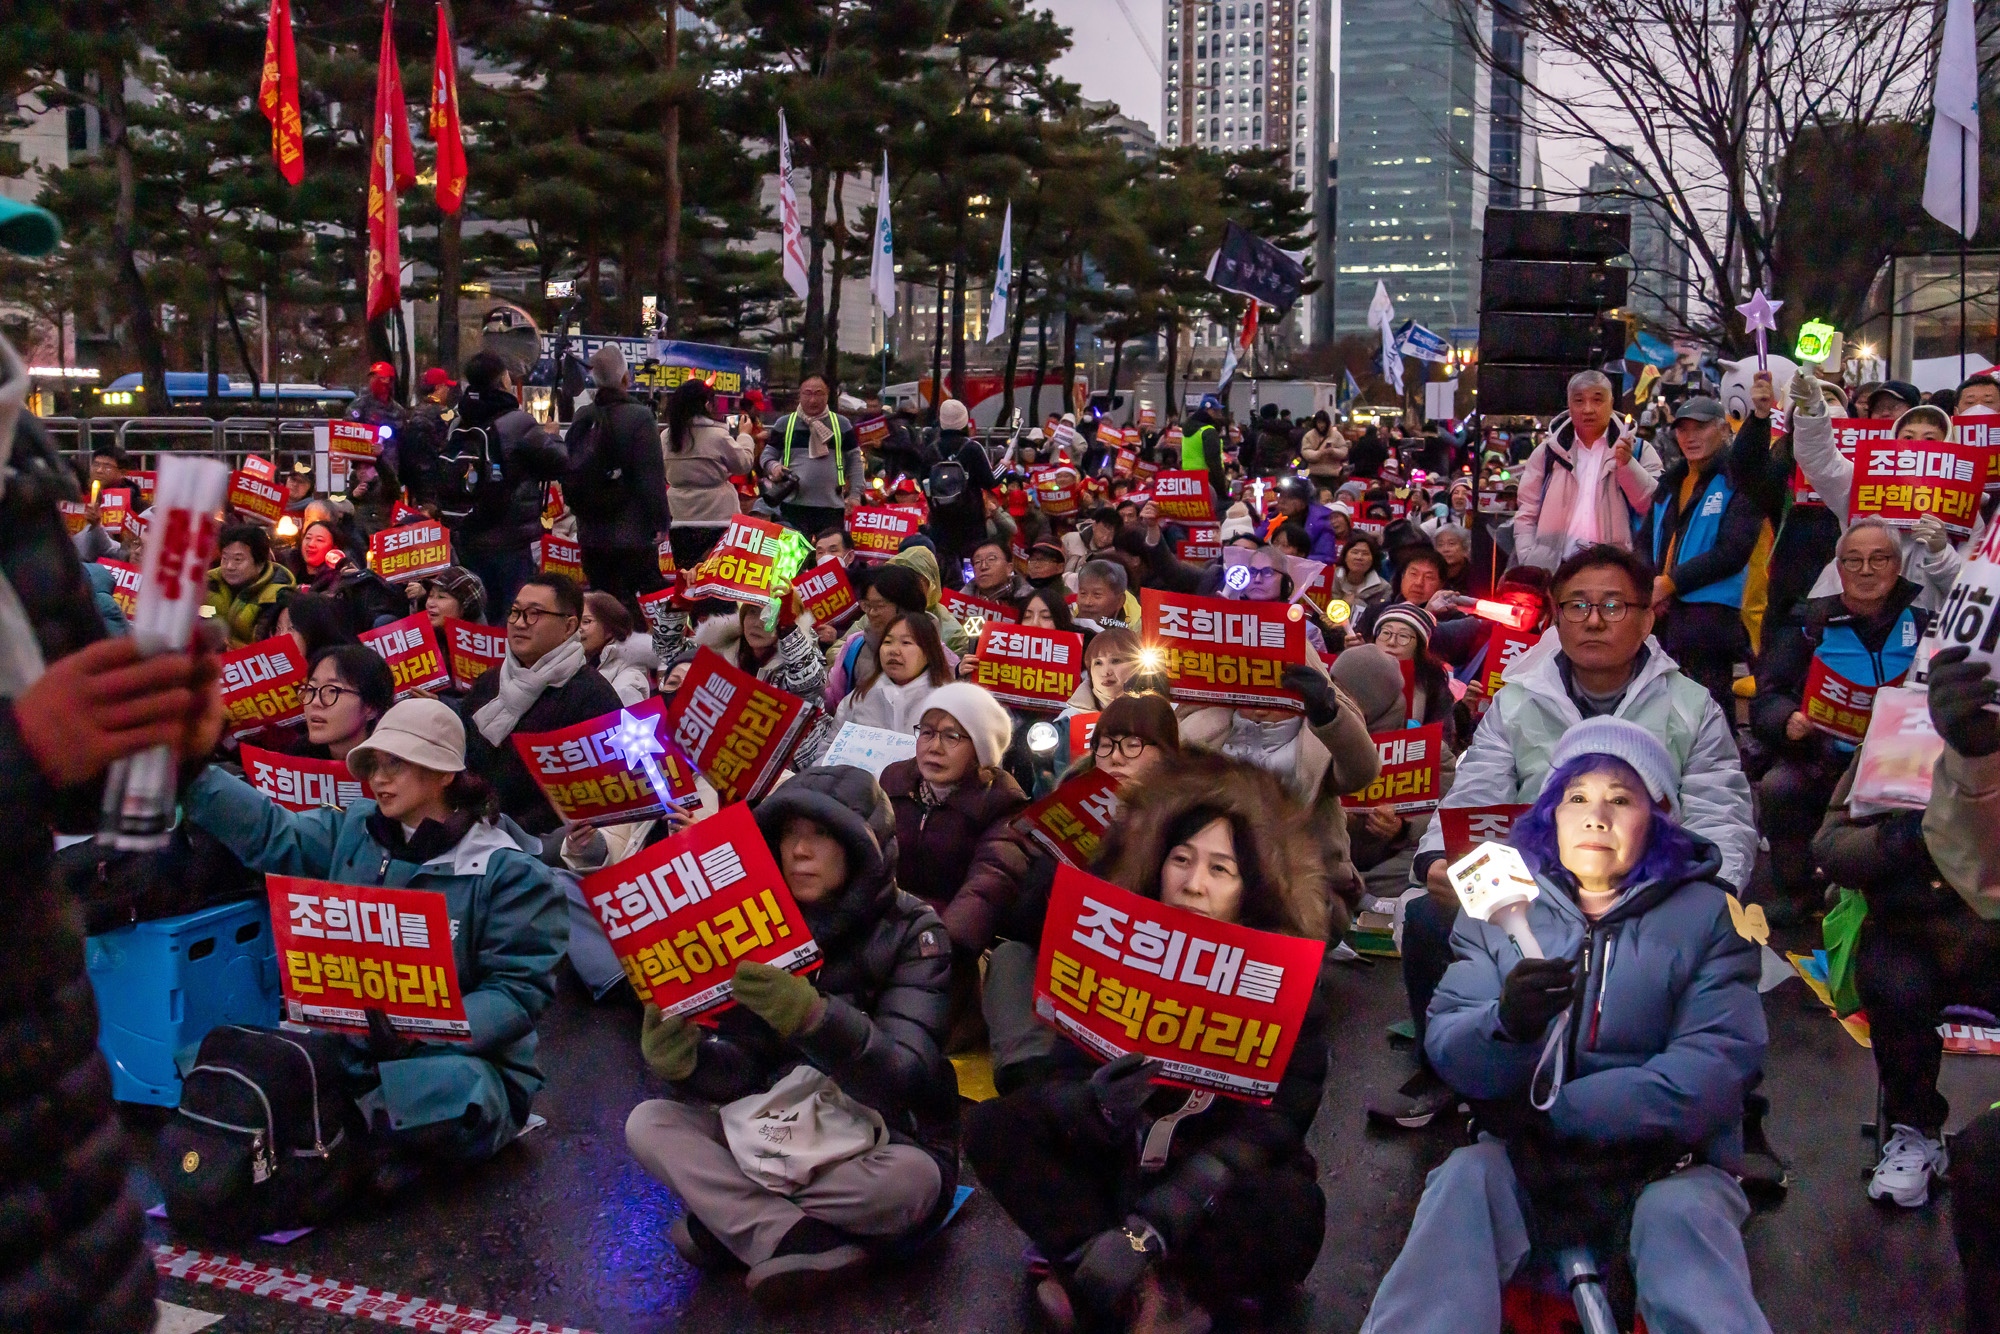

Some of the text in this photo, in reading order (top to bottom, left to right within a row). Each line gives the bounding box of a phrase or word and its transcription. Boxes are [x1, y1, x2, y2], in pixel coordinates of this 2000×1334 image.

[334, 424, 374, 441] 조희대를
[1831, 427, 1891, 452] 희대
[1955, 424, 2000, 448] 대를
[244, 456, 270, 474] 대를
[1868, 450, 1974, 482] 조희대를
[237, 476, 283, 502] 조희대를
[1156, 477, 1202, 496] 조희대를
[1858, 485, 1975, 520] 탄핵하라!
[231, 491, 281, 518] 탄핵하라!
[855, 511, 908, 533] 조희대를
[384, 526, 442, 553] 조희대를
[1185, 546, 1222, 559] 조희대
[381, 545, 447, 574] 탄핵하라!
[797, 571, 837, 602] 희대를
[813, 586, 852, 620] 하라!
[456, 627, 507, 657] 조희
[1158, 604, 1286, 649] 조희대를
[985, 630, 1070, 665] 조희대를
[391, 650, 438, 687] 하라!
[978, 660, 1074, 697] 탄핵하라!
[1163, 648, 1286, 690] 탄핵하라
[674, 672, 737, 764] 조희대를
[531, 723, 626, 774] 조희대
[708, 690, 789, 801] 탄핵하라!
[1378, 739, 1427, 766] 대를
[253, 760, 364, 809] 조희대를
[544, 755, 685, 813] 탄핵하라!
[1350, 767, 1432, 802] 하라!
[592, 841, 748, 941] 조희대를
[288, 893, 430, 949] 조희대를
[621, 888, 792, 1001] 탄핵하라!
[1071, 895, 1284, 1004] 조희대를
[285, 949, 452, 1009] 탄핵하라!
[1049, 949, 1282, 1069] 탄핵하라!
[1162, 1061, 1203, 1076] 대행진으로
[1203, 1068, 1230, 1082] 모이자!
[187, 1260, 274, 1286] DANGER!
[312, 1287, 355, 1303] 위험
[409, 1306, 496, 1331] 안전제일
